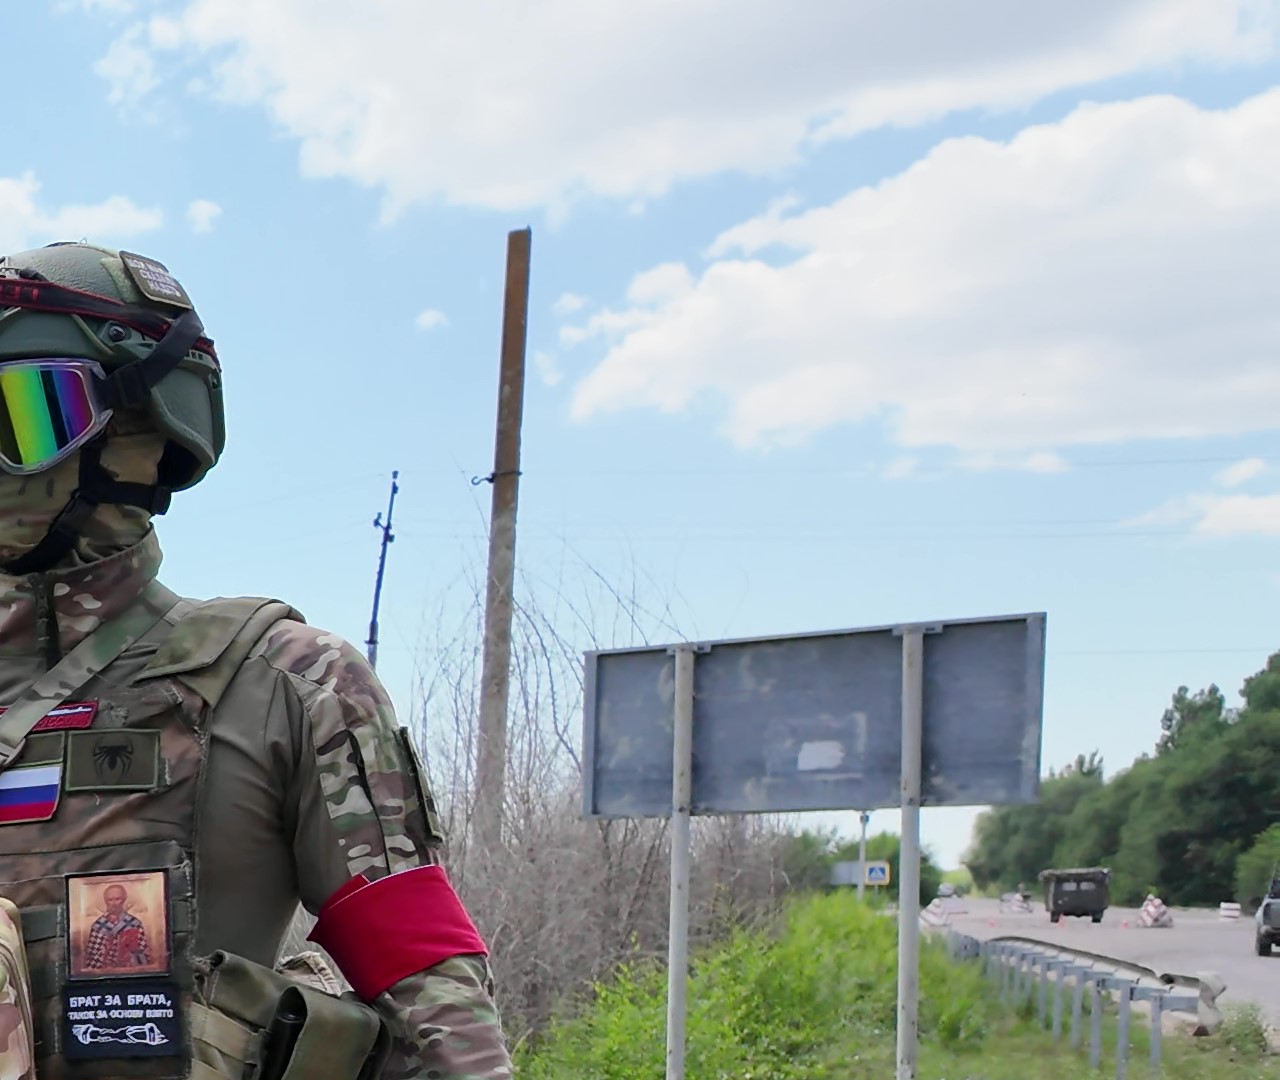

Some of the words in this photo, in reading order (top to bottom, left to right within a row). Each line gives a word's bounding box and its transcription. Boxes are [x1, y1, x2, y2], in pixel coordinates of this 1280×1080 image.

[69, 995, 102, 1008] БРАТ
[104, 994, 121, 1006] ЗА
[127, 993, 172, 1007] БРАТА,
[96, 1009, 108, 1019] ЗА
